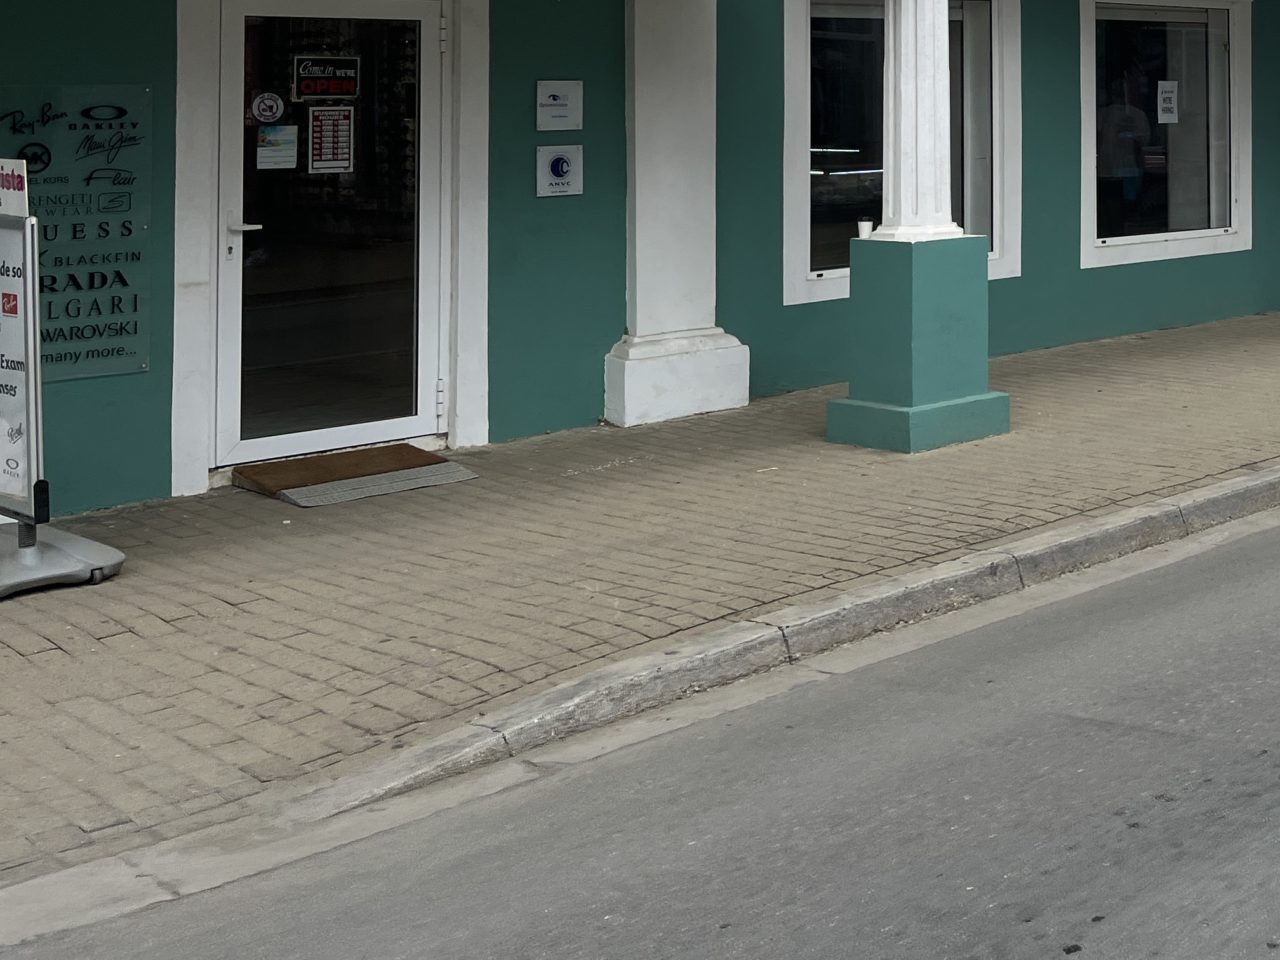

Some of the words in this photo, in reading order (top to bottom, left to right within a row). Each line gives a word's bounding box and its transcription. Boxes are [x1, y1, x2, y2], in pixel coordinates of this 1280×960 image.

[301, 80, 355, 94] OPEN
[68, 122, 139, 131] OAKLEY
[0, 166, 25, 192] ista
[42, 220, 133, 241] UESS
[54, 251, 141, 267] BLACKFIN
[40, 269, 130, 294] RADA
[47, 293, 138, 320] LGARI
[40, 320, 138, 343] WAROVSKI
[41, 351, 81, 365] many
[0, 383, 17, 397] nses
